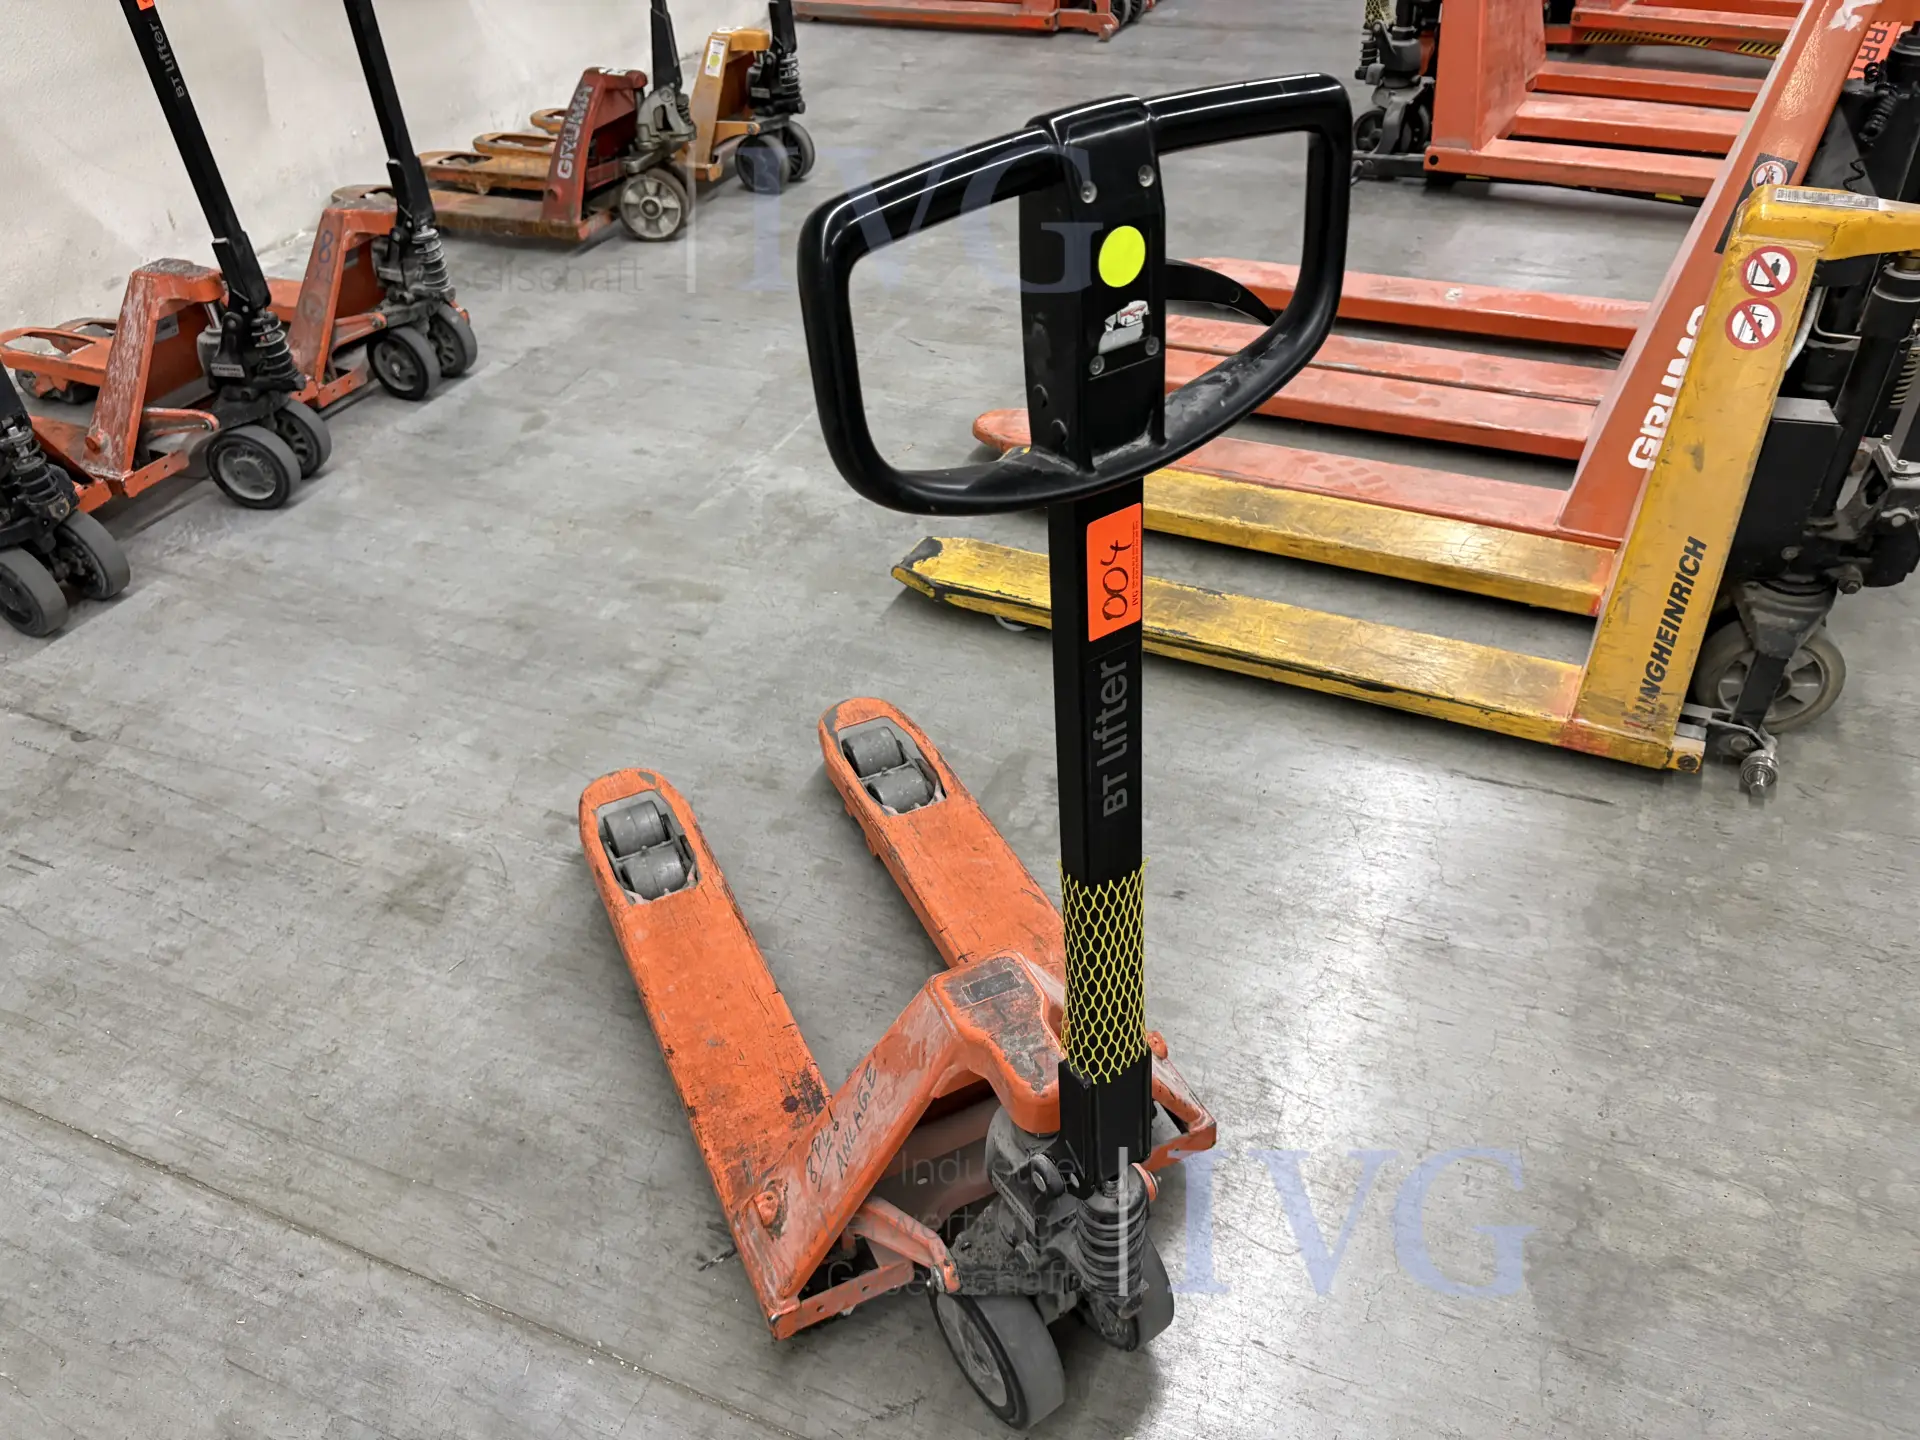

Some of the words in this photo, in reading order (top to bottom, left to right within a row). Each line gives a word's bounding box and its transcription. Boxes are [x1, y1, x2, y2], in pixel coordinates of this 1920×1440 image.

[148, 22, 176, 72] Lifter
[171, 76, 186, 99] BT
[1098, 538, 1133, 622] 004
[1092, 658, 1129, 768] Lifter
[1102, 773, 1129, 819] BT
